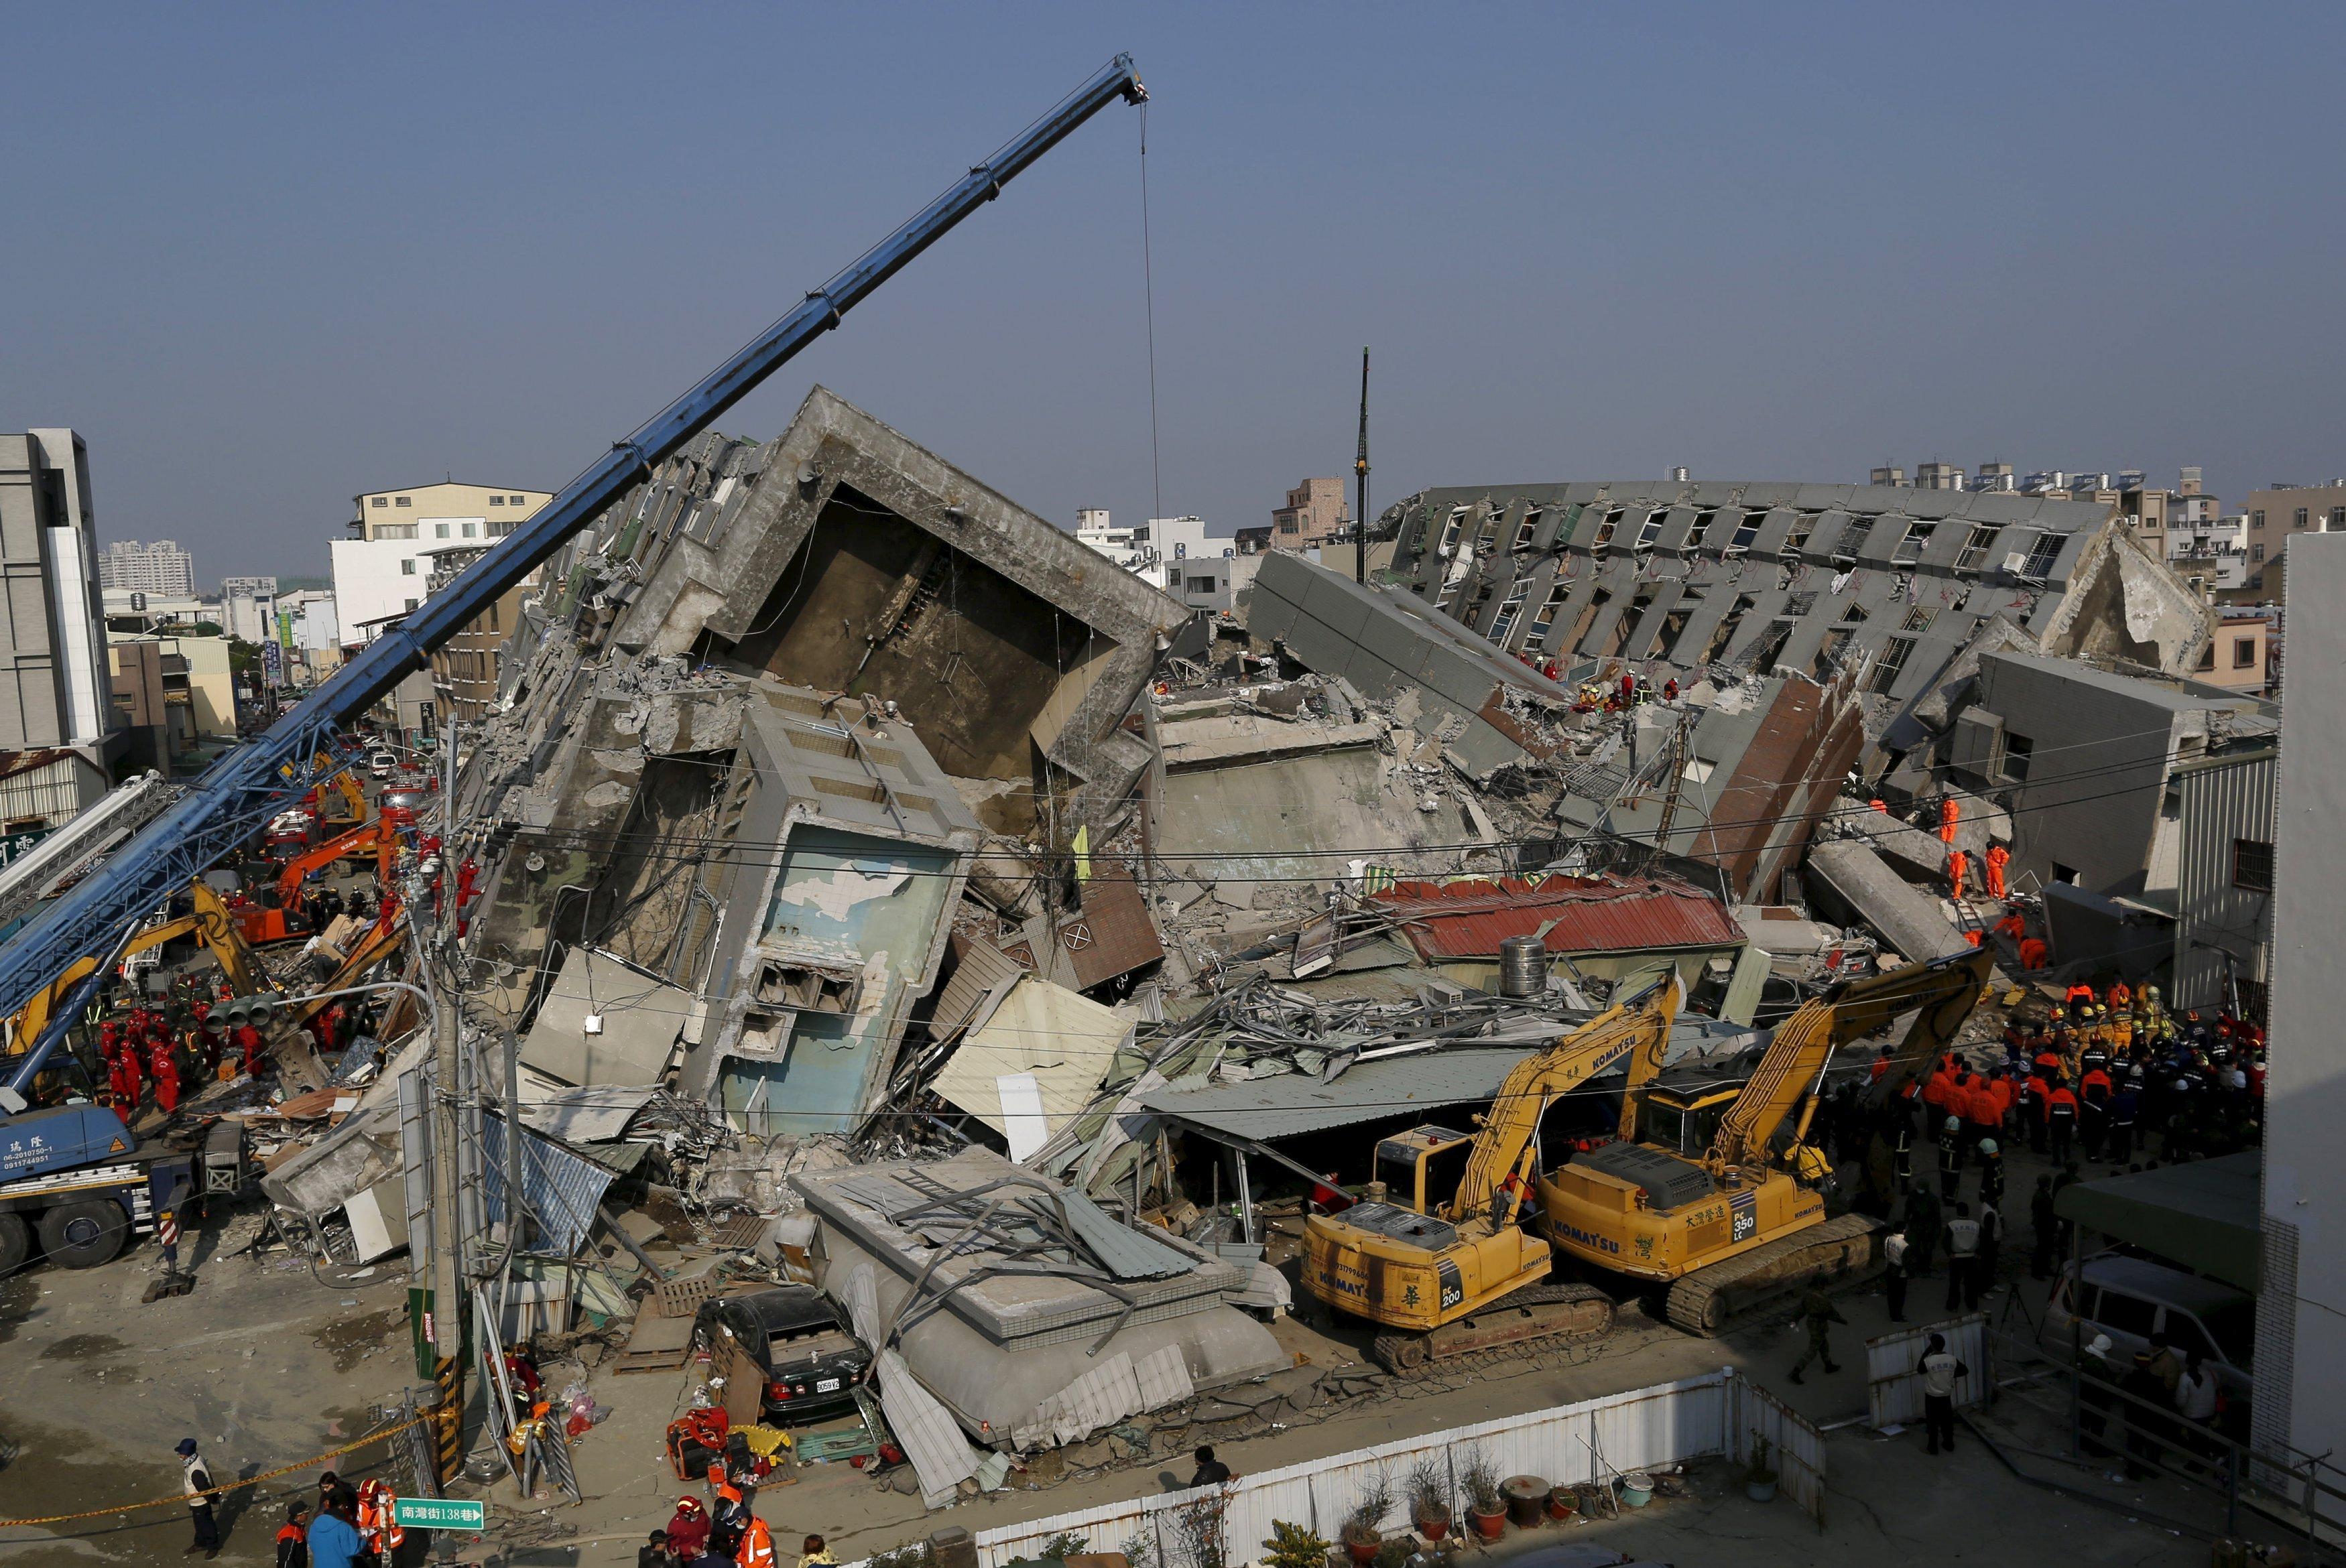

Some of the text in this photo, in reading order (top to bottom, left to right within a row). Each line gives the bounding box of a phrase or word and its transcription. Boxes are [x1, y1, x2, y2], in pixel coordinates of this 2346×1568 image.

[1593, 1034, 1636, 1070] KOMATSU
[10, 1135, 43, 1152] 瑞隆
[4, 1155, 48, 1170] 0911744951
[1686, 1205, 1725, 1229] 大灣營造
[1734, 1212, 1744, 1222] PC
[1794, 1203, 1823, 1219] KOMATSU
[1734, 1217, 1753, 1232] 350
[1554, 1219, 1619, 1254] KOMATSU
[1734, 1232, 1743, 1241] LC
[1522, 1253, 1550, 1270] KOMATSU
[1401, 1285, 1421, 1309] 華
[1442, 1290, 1461, 1307] 200
[402, 1506, 473, 1521] 南灣街138巷
